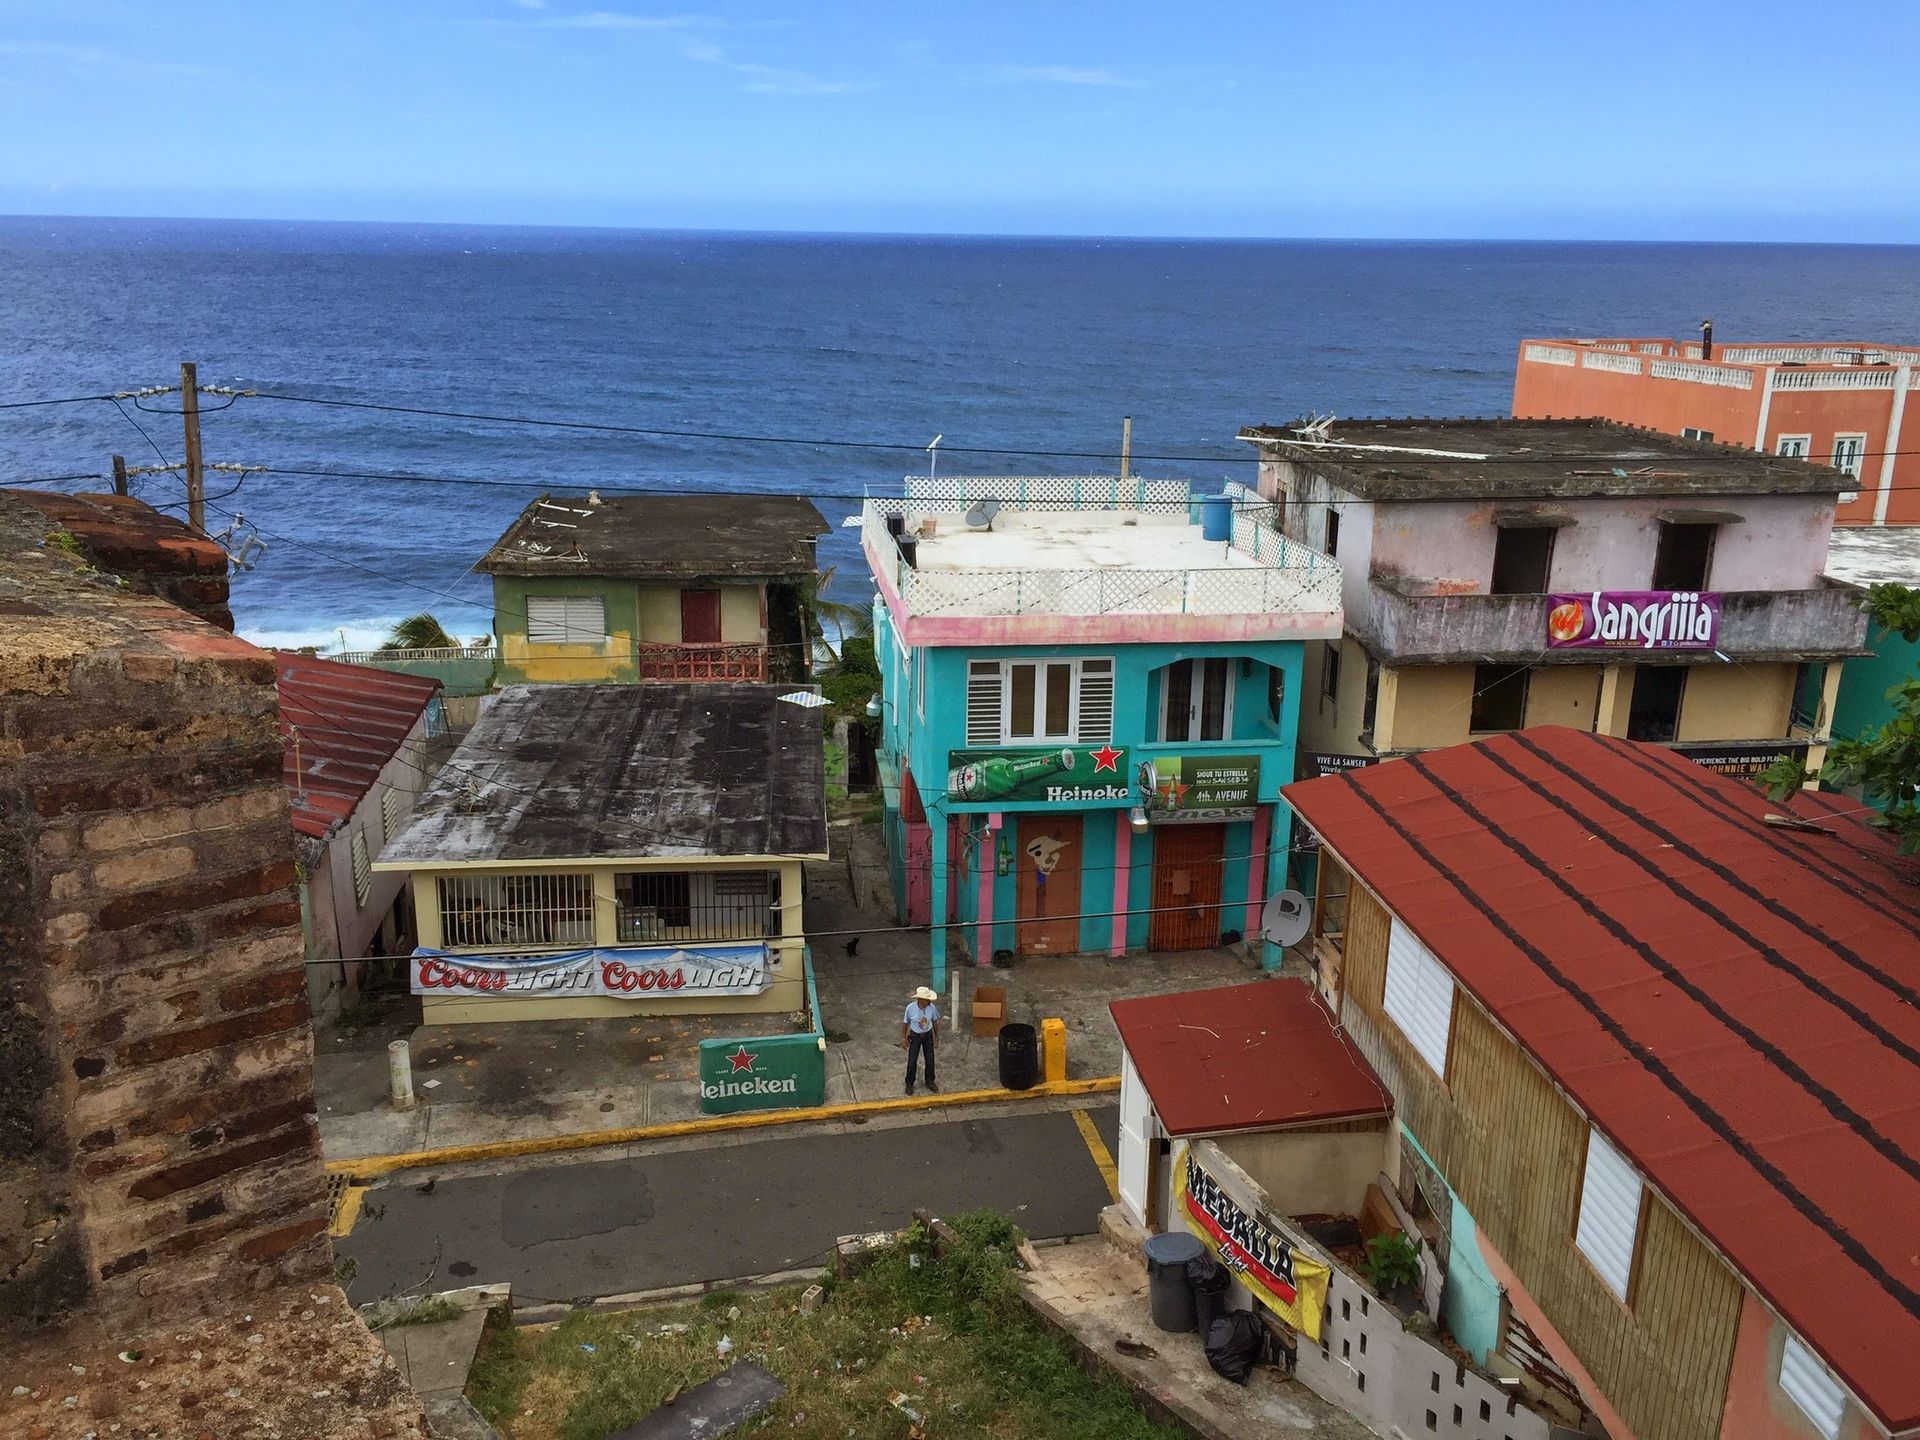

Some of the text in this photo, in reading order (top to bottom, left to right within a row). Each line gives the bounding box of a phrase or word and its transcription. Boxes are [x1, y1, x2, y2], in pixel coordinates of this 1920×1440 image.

[1589, 591, 1712, 649] Sangriiia
[1196, 770, 1214, 778] SIGUE
[1317, 756, 1330, 764] VIVE
[418, 958, 594, 991] Coors LIGHT
[600, 960, 686, 992] Coors
